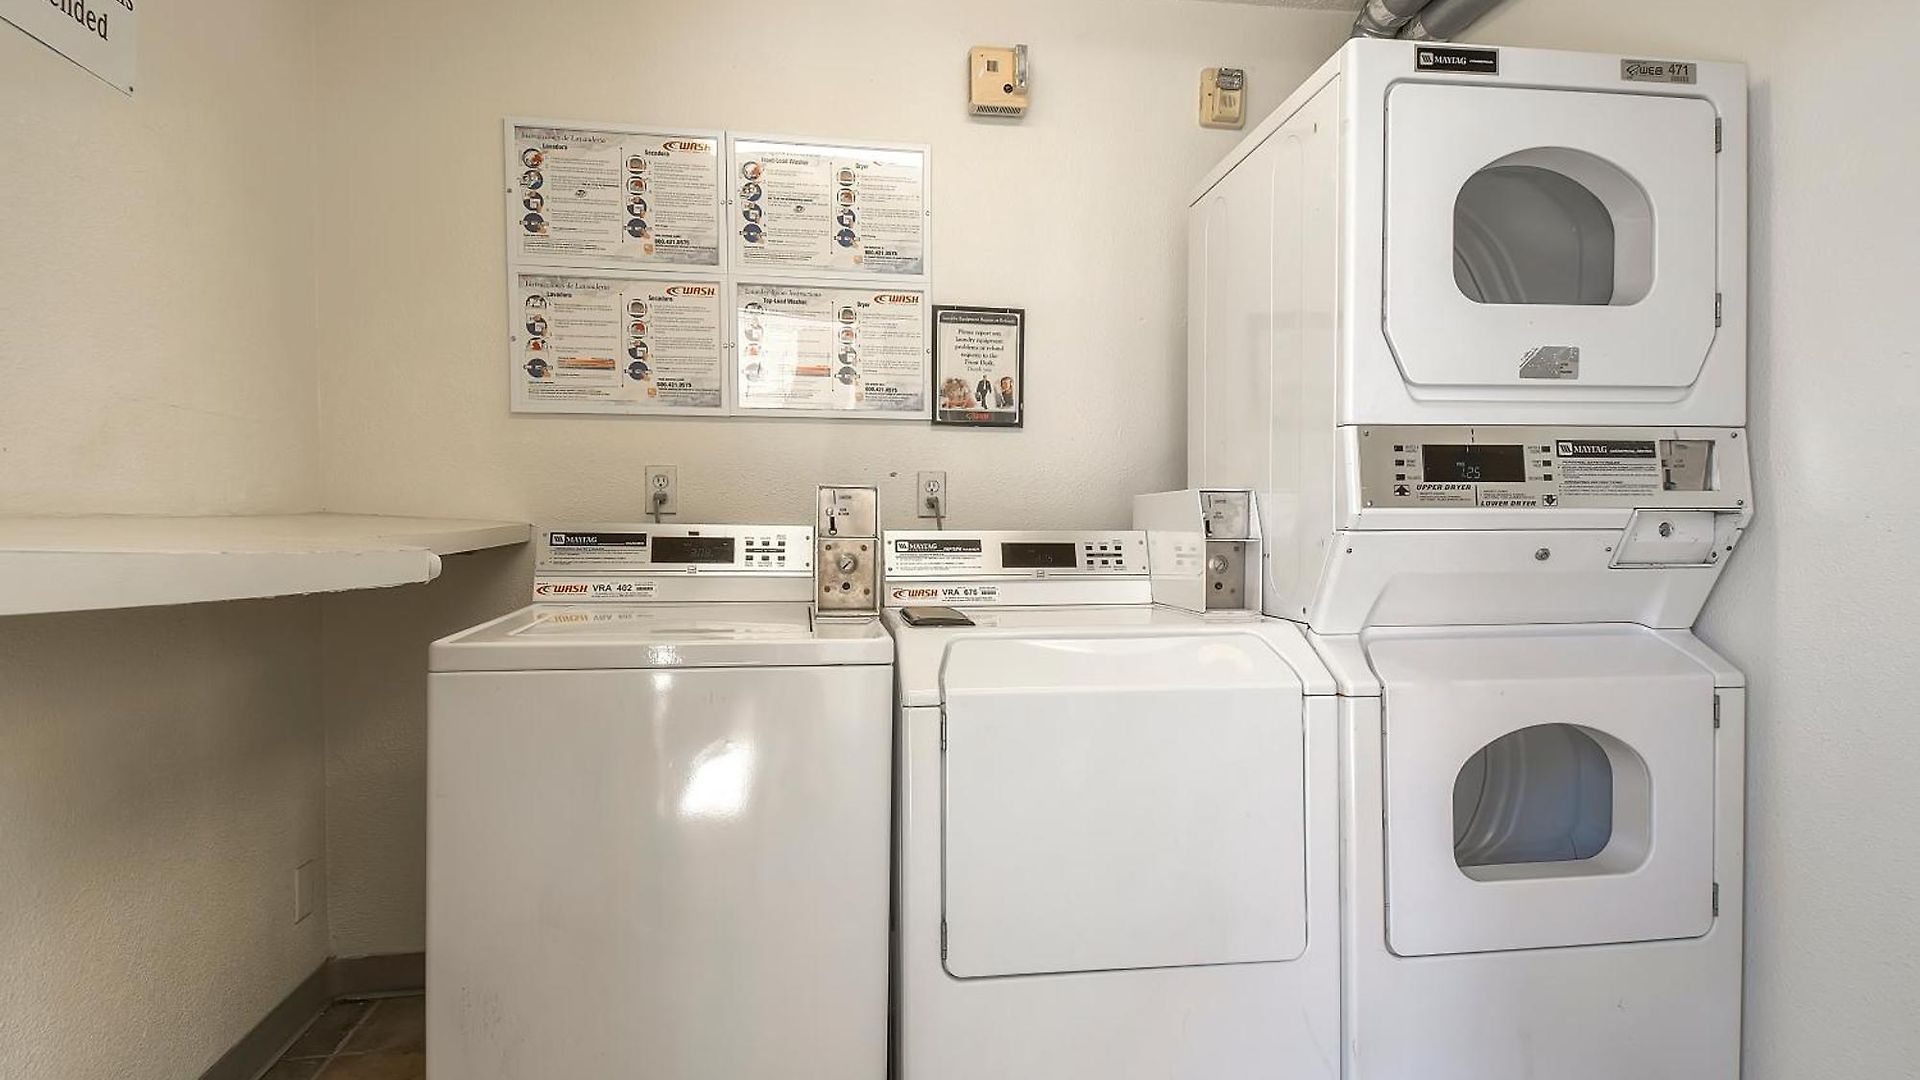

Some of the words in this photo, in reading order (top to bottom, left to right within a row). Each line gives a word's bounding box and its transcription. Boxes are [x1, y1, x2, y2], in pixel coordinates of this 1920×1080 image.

[1434, 55, 1467, 65] MAYTAG
[1640, 66, 1664, 76] WEB
[1668, 63, 1688, 76] 471
[682, 286, 716, 296] WASH
[889, 294, 919, 304] WASH
[1573, 445, 1608, 454] MAYTAG
[565, 536, 598, 544] MAYTAG
[553, 584, 588, 593] WASH
[592, 583, 613, 592] VRA
[616, 583, 633, 592] 402
[909, 588, 938, 598] WASH
[942, 588, 960, 596] VRA
